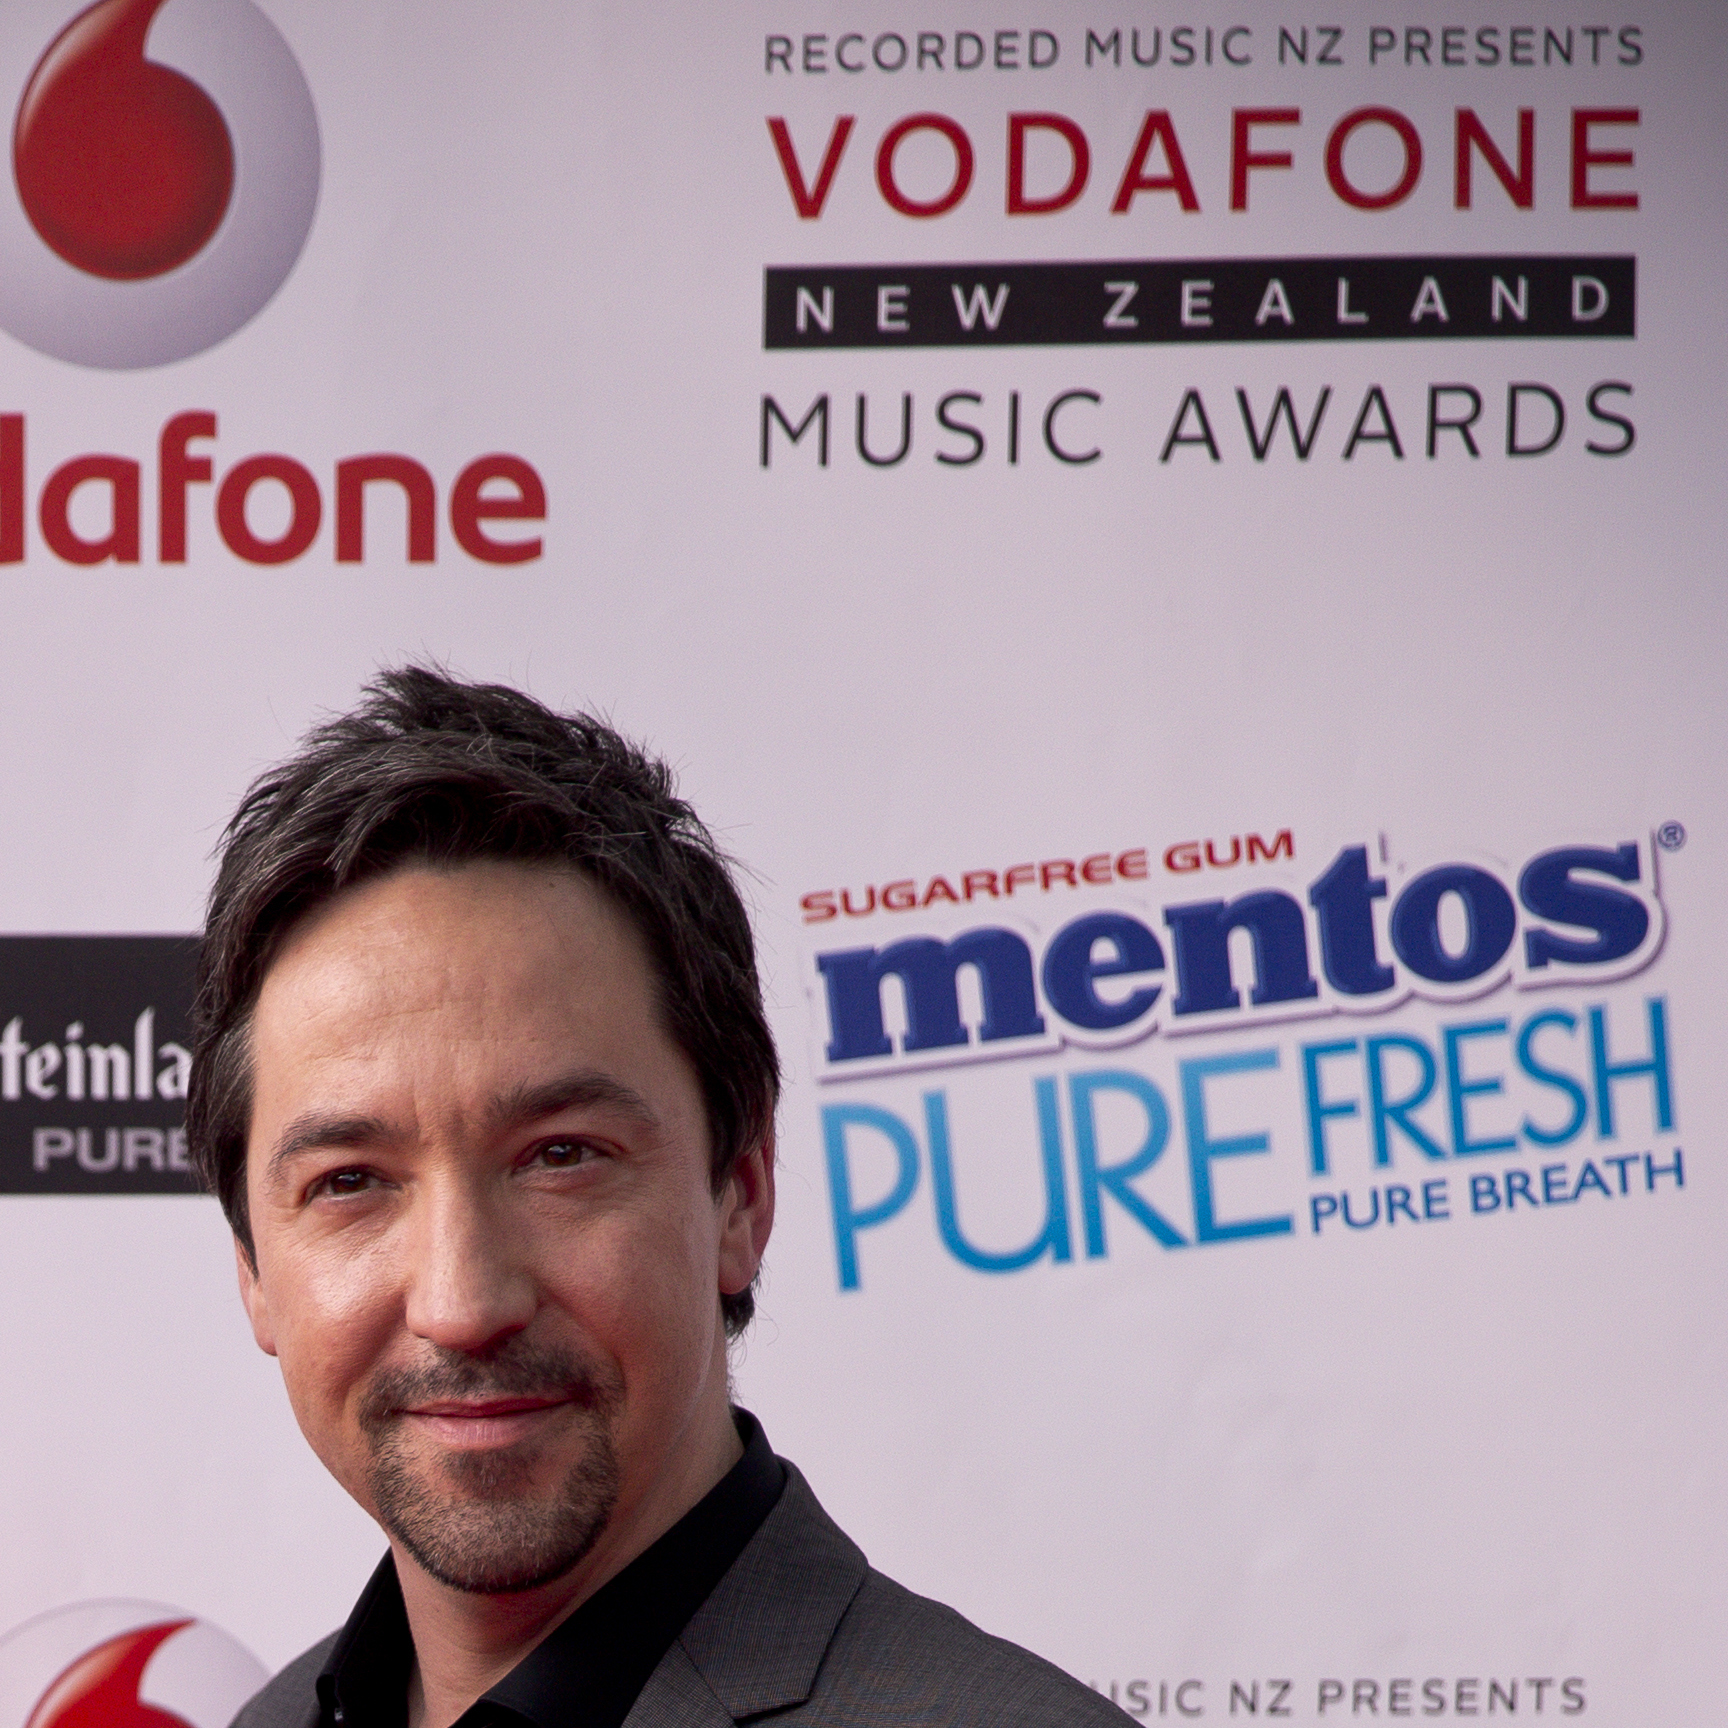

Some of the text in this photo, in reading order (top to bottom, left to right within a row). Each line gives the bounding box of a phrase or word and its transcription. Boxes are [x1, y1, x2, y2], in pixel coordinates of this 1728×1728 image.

[764, 24, 1645, 75] RECORDED MUSIC NZ PRESENTS
[767, 104, 1643, 220] VODAFONE
[795, 276, 1609, 333] NEW ZEALAND
[760, 379, 1637, 469] MUSIC AWARDS
[799, 829, 1295, 924] SUGARFREE GUM
[815, 840, 1656, 1064] mentos
[33, 1126, 198, 1172] PURE
[818, 994, 1676, 1294] PURE FRESH
[1309, 1141, 1685, 1235] PURE BREATH
[1229, 1679, 1293, 1717] NZ
[1317, 1676, 1587, 1717] PRESENTS
